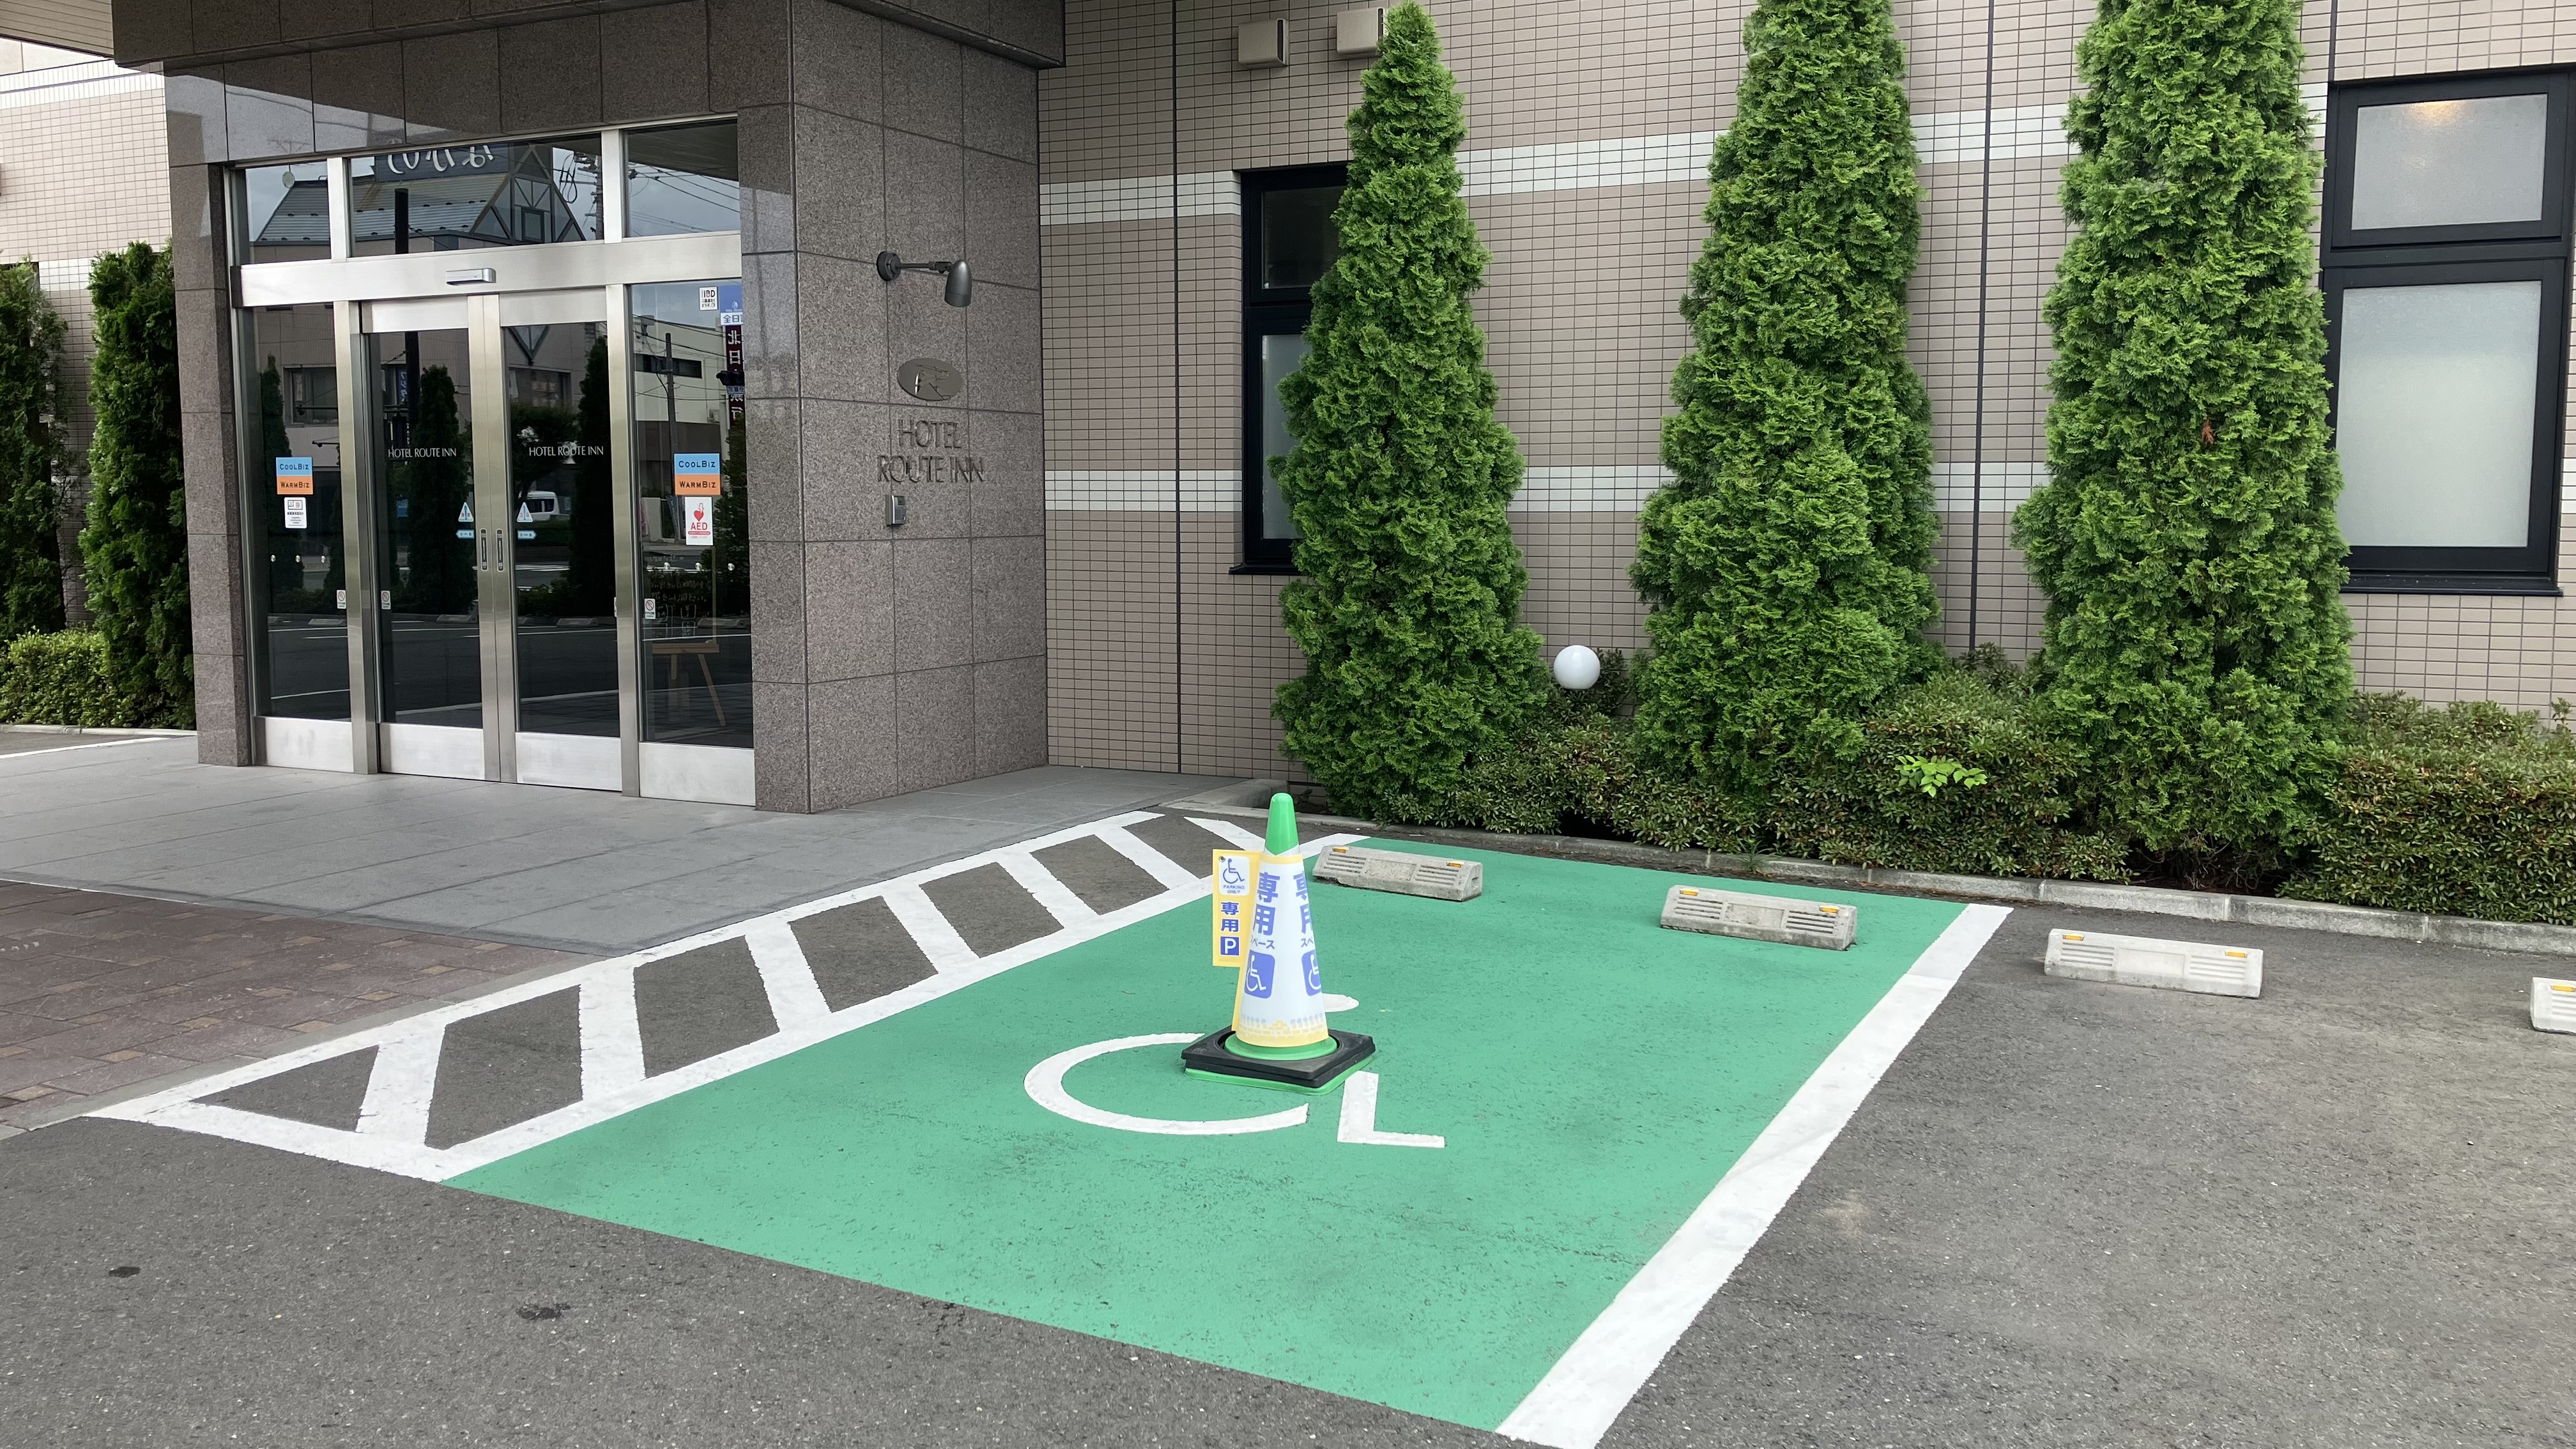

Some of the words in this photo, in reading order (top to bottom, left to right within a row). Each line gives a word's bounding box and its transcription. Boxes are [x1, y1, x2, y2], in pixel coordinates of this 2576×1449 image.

[898, 419, 962, 448] HOTEL
[388, 448, 413, 458] HOTEL
[414, 448, 441, 457] ROUTE
[441, 447, 457, 457] INN
[528, 446, 556, 457] HOTEL
[558, 445, 586, 456] ROUTE
[588, 446, 604, 456] INN
[877, 455, 944, 483] ROUTE
[949, 456, 984, 483] INN
[690, 522, 708, 530] AED
[1253, 871, 1280, 936] 専用
[1221, 901, 1239, 932] 専用
[1223, 937, 1238, 954] P
[1250, 935, 1275, 950] ペース
